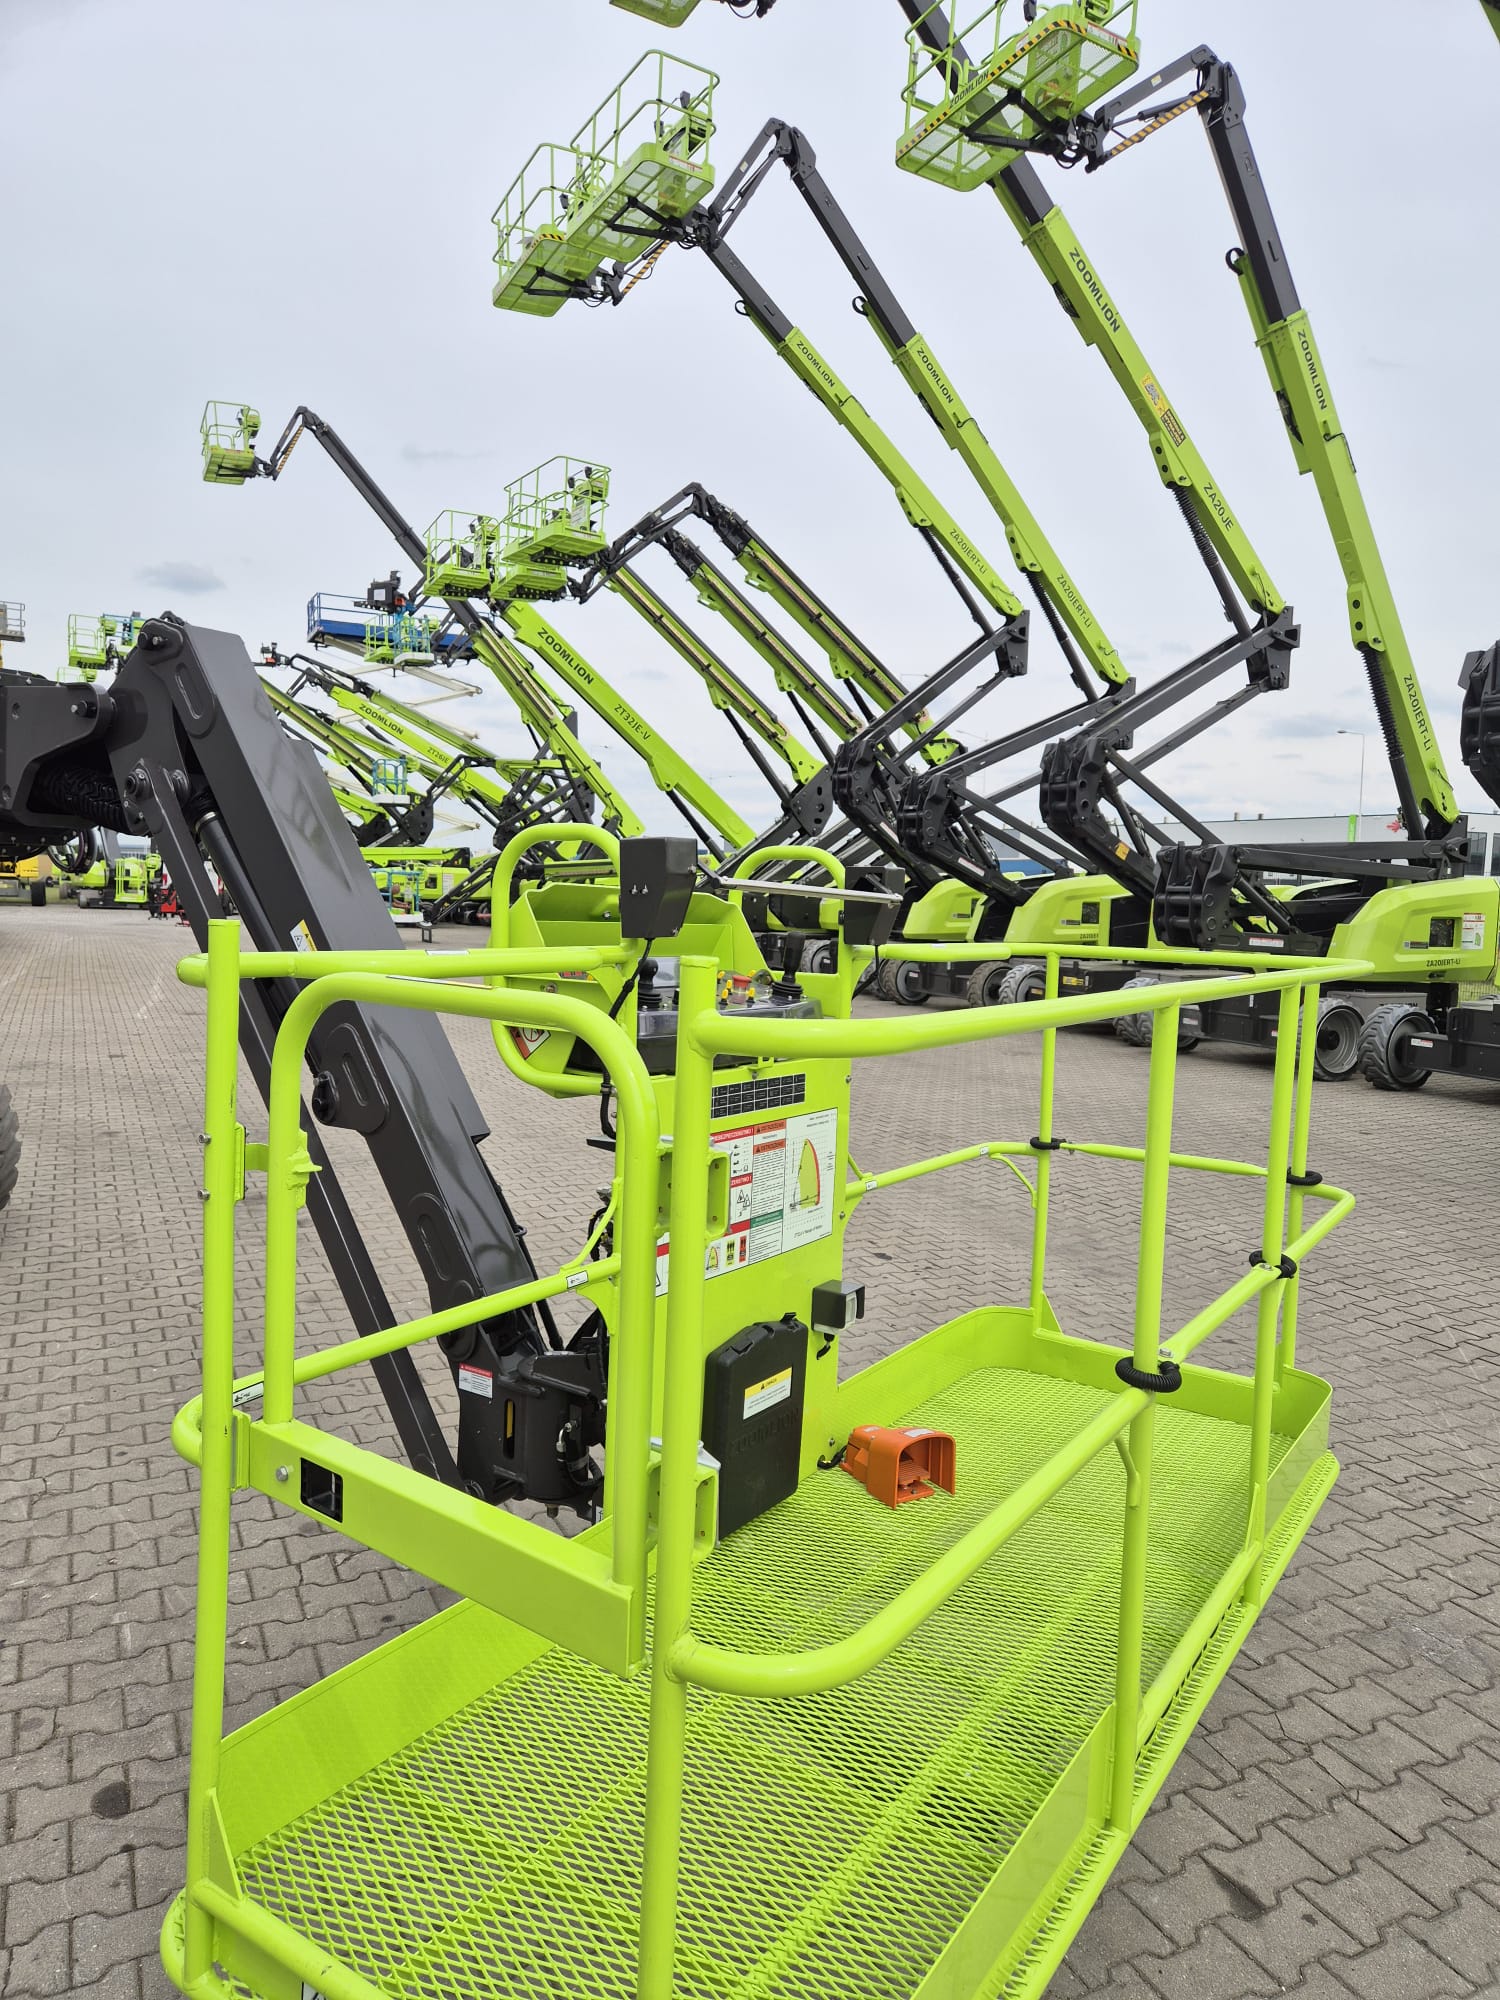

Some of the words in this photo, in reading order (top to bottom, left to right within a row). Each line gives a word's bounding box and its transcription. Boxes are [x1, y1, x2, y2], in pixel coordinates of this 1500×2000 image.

[1069, 247, 1120, 333] ZOOMLION
[796, 340, 835, 388] ZOOMLION
[917, 348, 954, 404] ZOOMLION
[1297, 329, 1328, 410] ZOOMLION
[1203, 482, 1234, 532] ZA20JE
[1057, 574, 1093, 628] ZA20JERT-Li
[537, 627, 594, 685] ZOOMLION
[359, 704, 404, 735] ZOOMLION
[614, 704, 651, 740] ZT32JE-V
